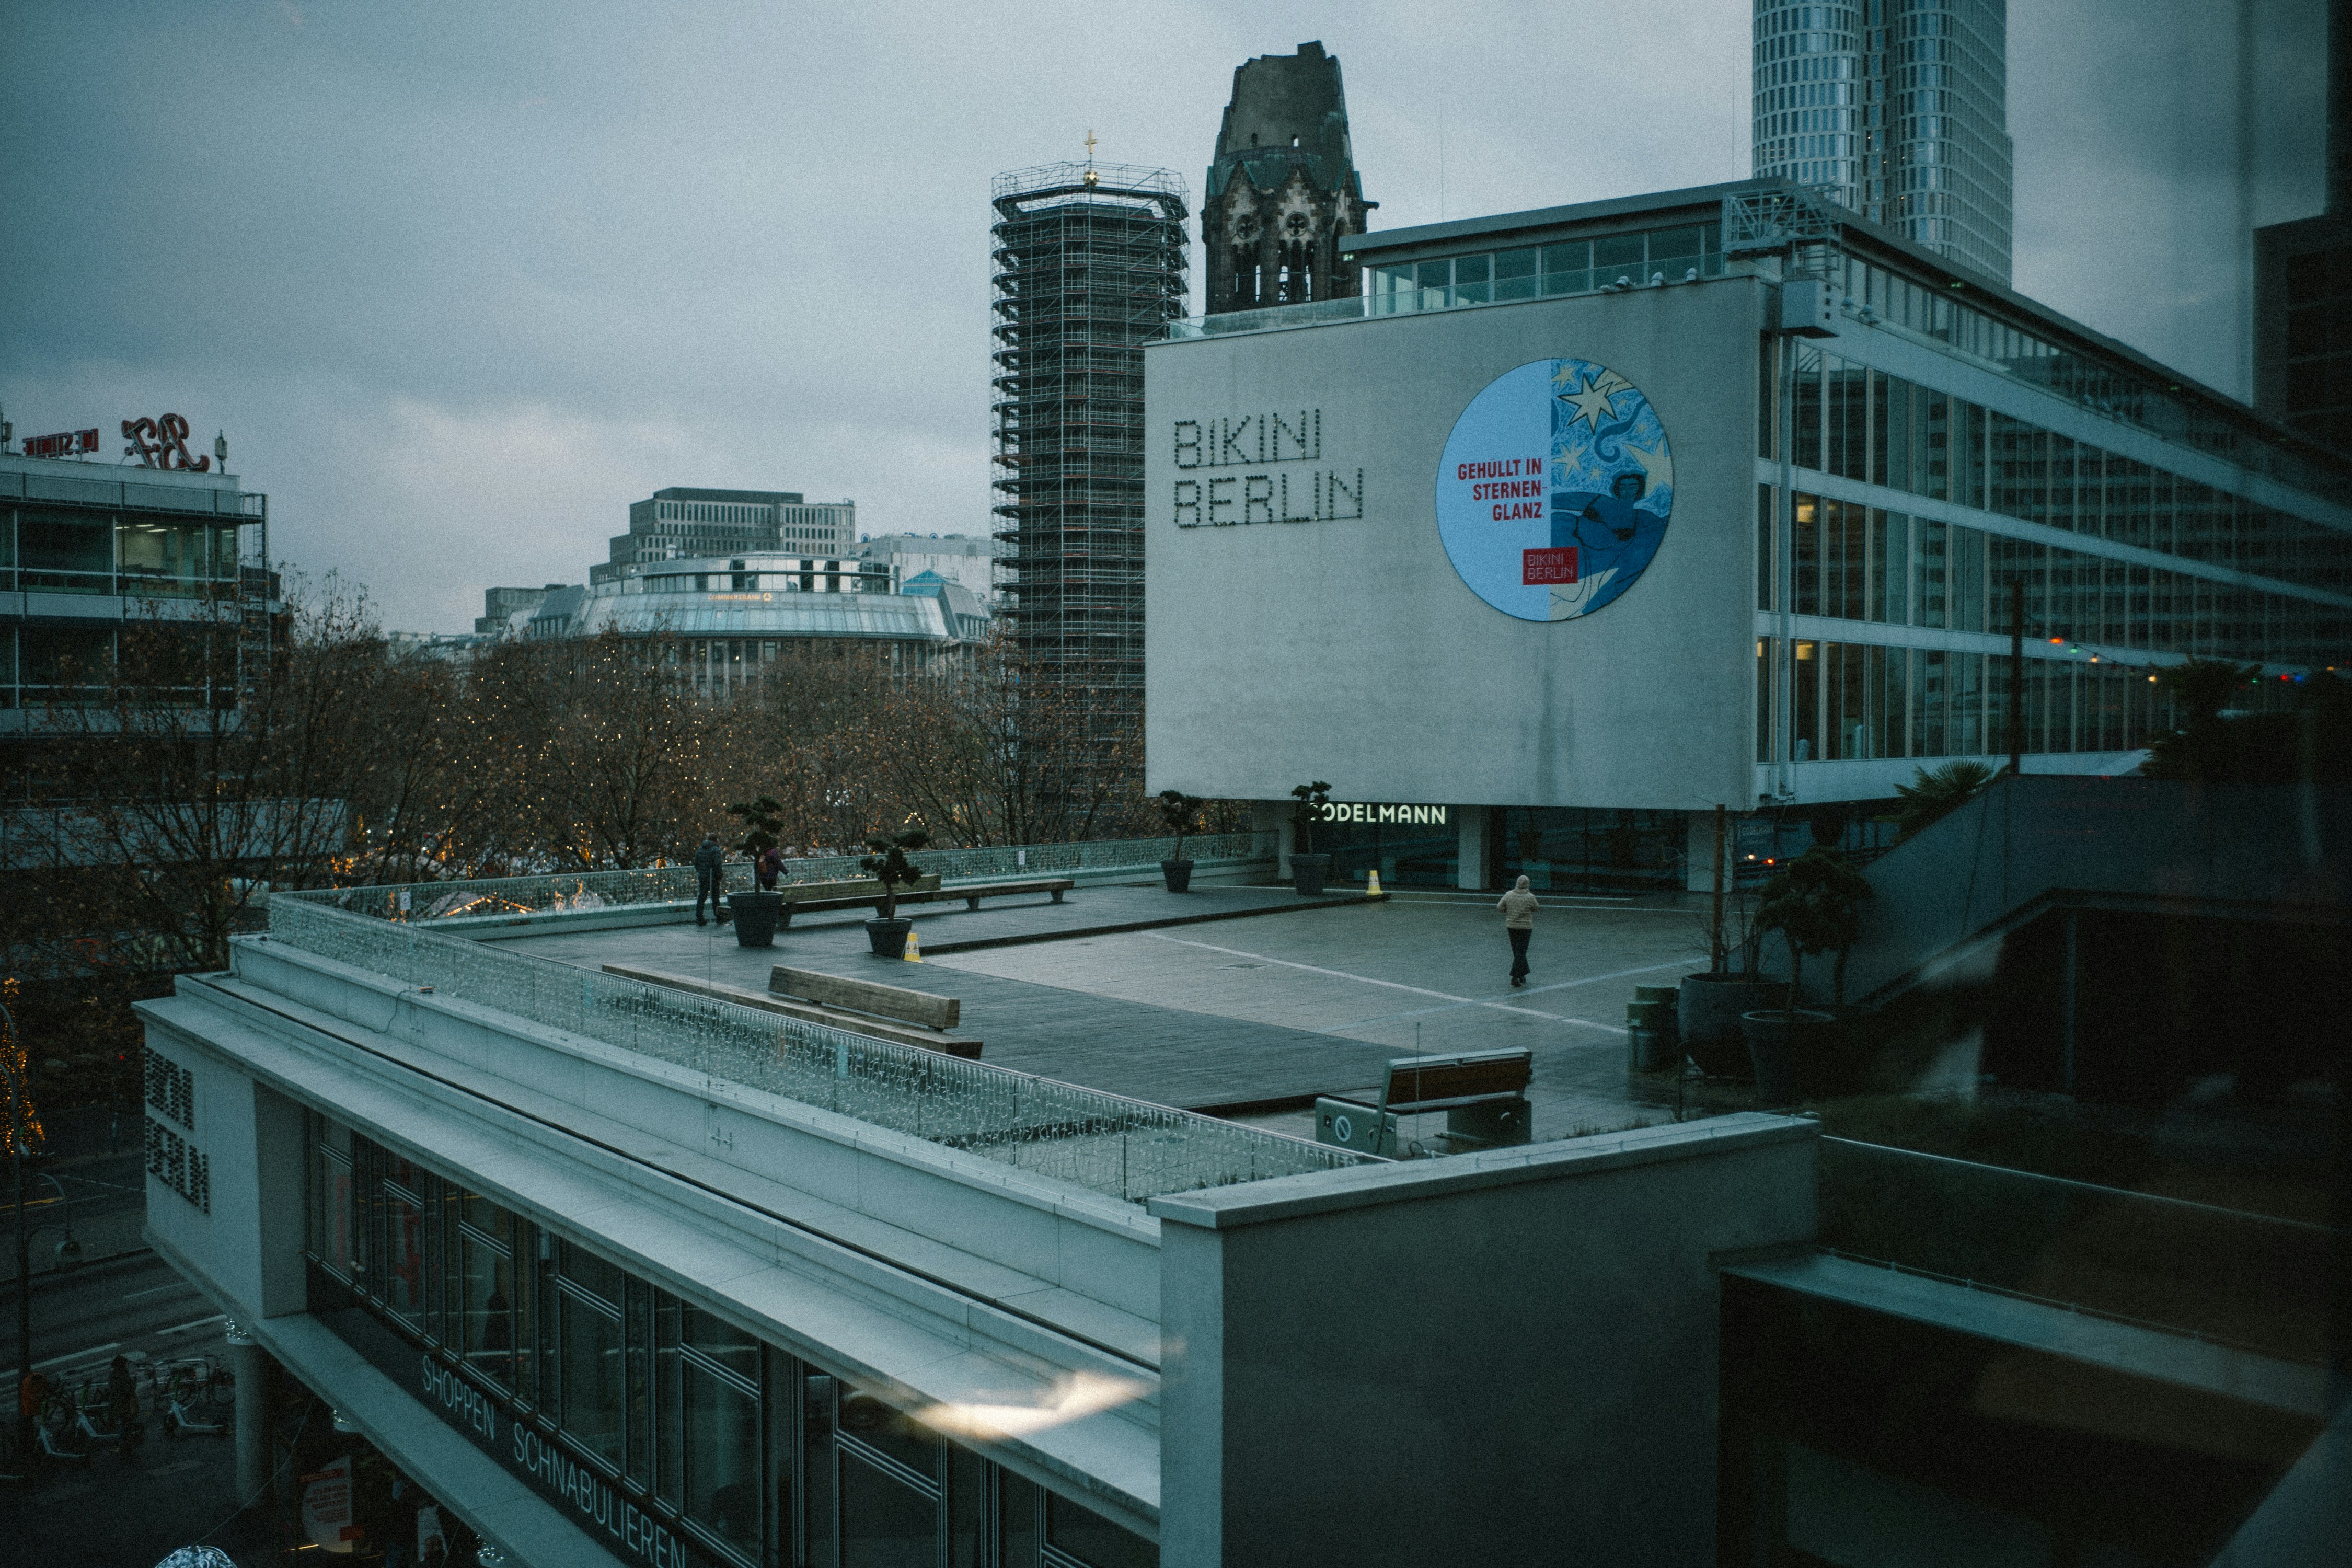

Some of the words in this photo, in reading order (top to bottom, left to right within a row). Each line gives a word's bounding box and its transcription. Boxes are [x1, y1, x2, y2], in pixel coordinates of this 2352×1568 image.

[1174, 408, 1320, 469] BIKINI
[1526, 457, 1542, 475] IN
[1174, 468, 1362, 529] BERLIN
[1472, 480, 1548, 501] STERNEN-
[1527, 552, 1564, 566] BIKINI
[1527, 566, 1573, 580] BERLIN
[422, 1354, 495, 1440] SHOPPEN
[513, 1422, 685, 1568] SCHNABULIEREN
